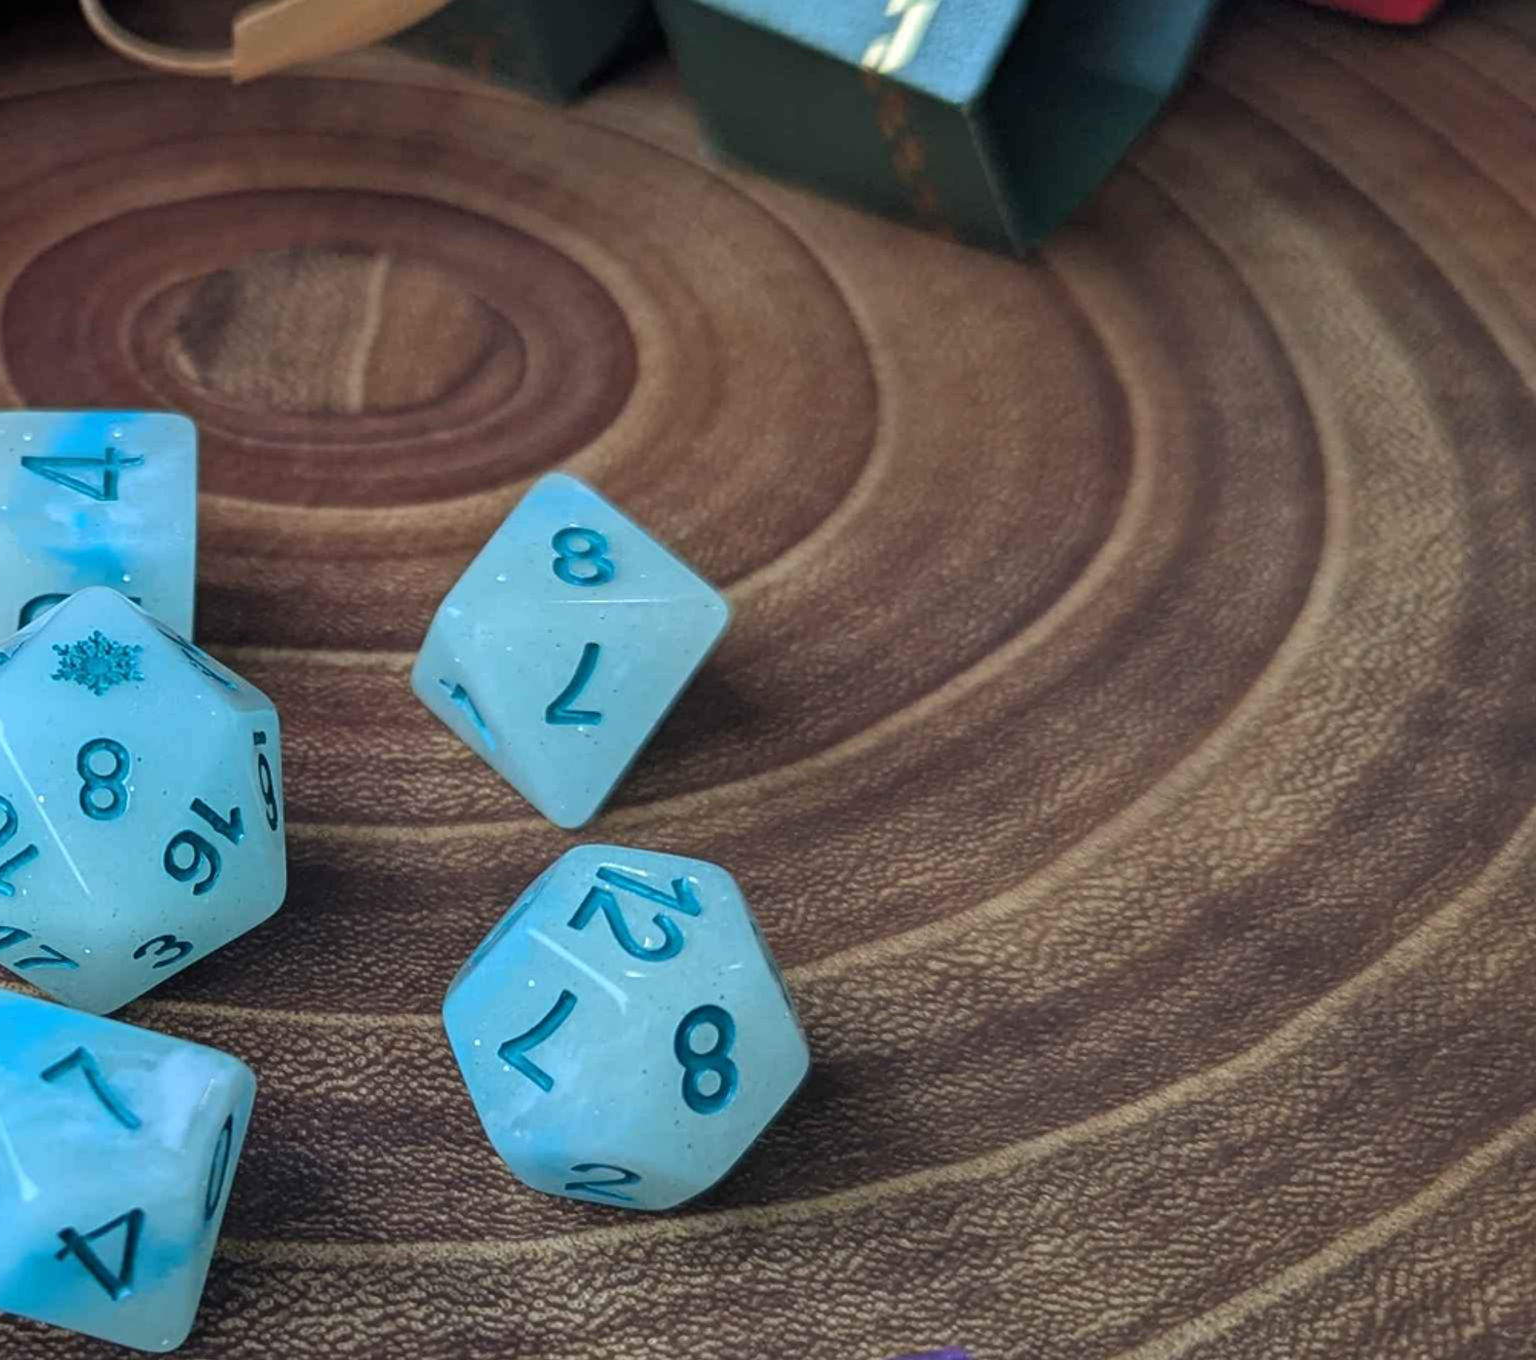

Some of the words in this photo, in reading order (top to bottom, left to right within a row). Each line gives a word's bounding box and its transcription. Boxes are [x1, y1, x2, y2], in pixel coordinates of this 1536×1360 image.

[21, 447, 145, 501] 4
[552, 527, 616, 587] 8
[545, 642, 602, 725] 7
[76, 737, 131, 821] 8
[164, 797, 245, 896] 16
[133, 934, 194, 969] 3
[567, 866, 702, 962] 12
[497, 989, 578, 1093] 7
[674, 1004, 739, 1115] 8
[40, 1046, 142, 1130] 7
[564, 1163, 641, 1201] 2
[54, 1208, 144, 1301] 4
